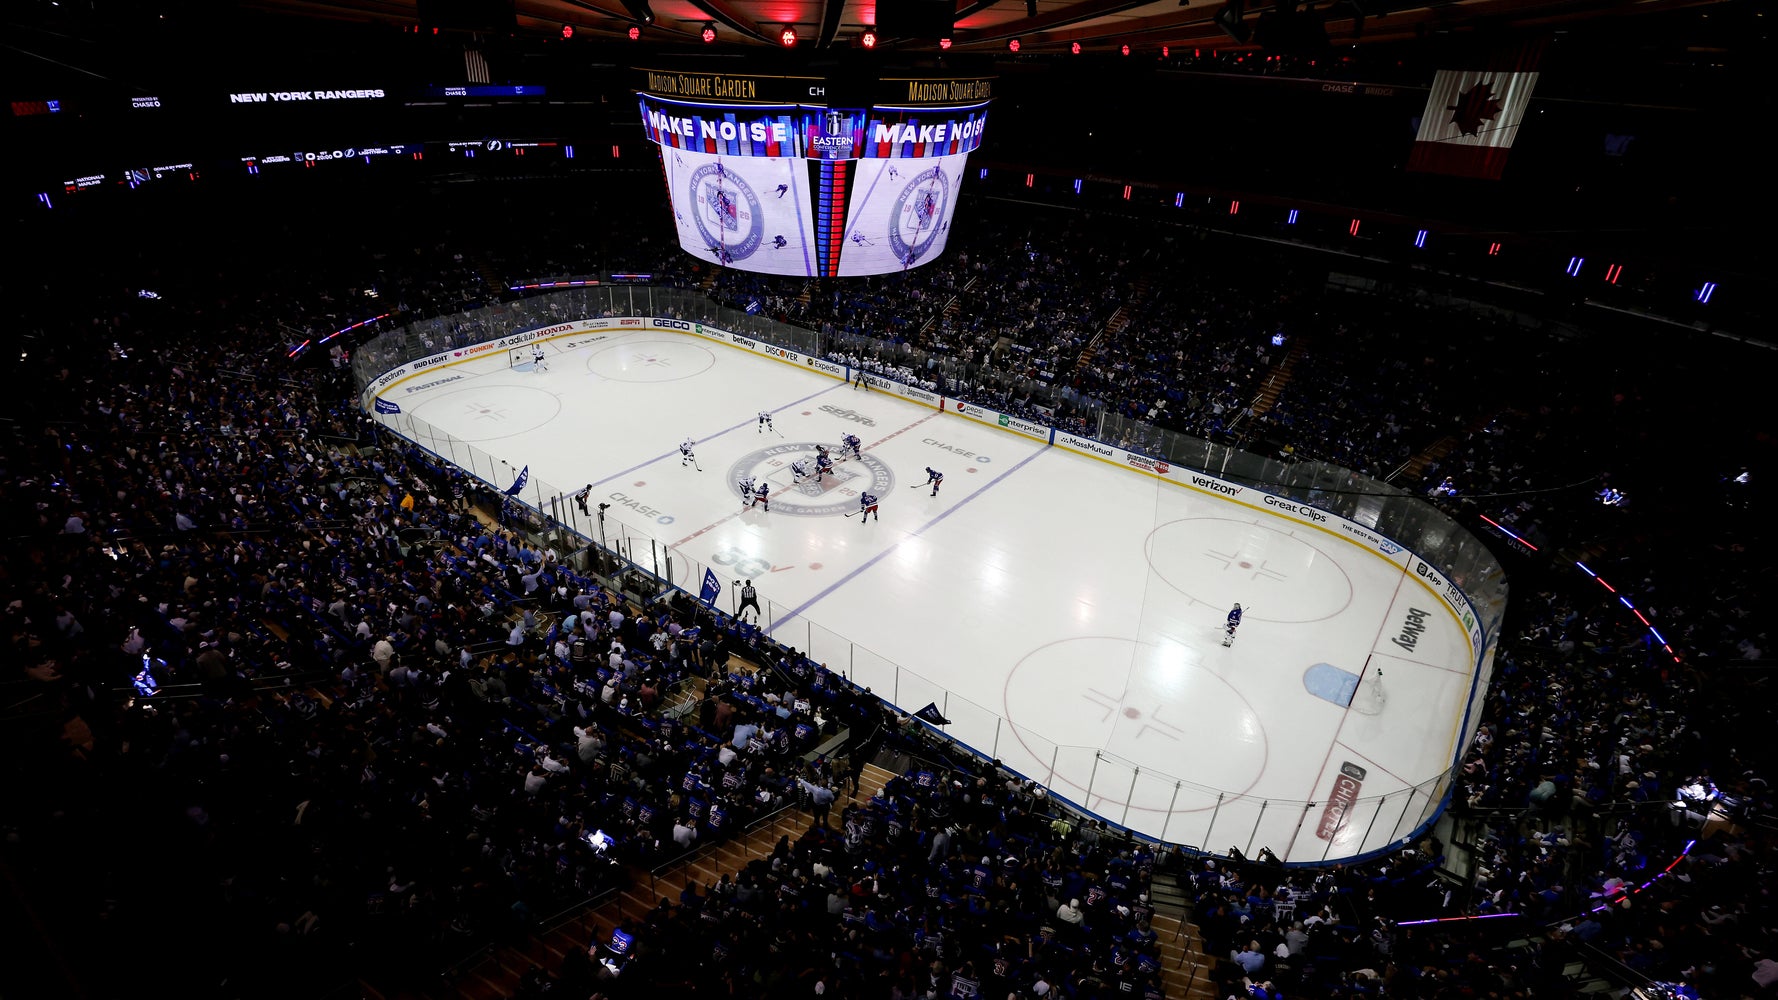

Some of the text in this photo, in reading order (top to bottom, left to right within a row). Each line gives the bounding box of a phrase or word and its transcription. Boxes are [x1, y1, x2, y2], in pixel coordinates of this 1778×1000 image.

[649, 72, 756, 98] MADISON SQUARE GARDEN
[908, 81, 948, 102] MADISON
[950, 80, 974, 100] SQUARE
[229, 89, 385, 103] NEW YORK RANGERS
[648, 110, 787, 142] MAKE NOISE
[874, 124, 946, 143] MAKE
[813, 136, 853, 146] EASTERN
[536, 325, 574, 337] HONDA
[653, 318, 690, 330] GEICO
[508, 332, 536, 345] adiclub
[732, 334, 756, 349] betway
[765, 345, 798, 361] DISCOVER
[413, 355, 448, 369] BUD LIGHT
[814, 360, 840, 374] Expedia
[379, 369, 406, 386] Spectrum
[405, 375, 465, 393] FASTENAL
[966, 405, 984, 415] pepsi
[765, 444, 800, 456] NEW
[922, 438, 976, 458] CHASE
[1069, 438, 1114, 457] MassMutual
[1126, 453, 1156, 467] guaranteed
[1192, 475, 1237, 496] verizon
[609, 492, 661, 519] CHASE
[1263, 495, 1327, 523] Great Clips
[1342, 523, 1380, 545] THE BEST RUN
[1380, 541, 1400, 554] SAP
[1446, 582, 1467, 608] TRULY
[1391, 607, 1432, 653] betway
